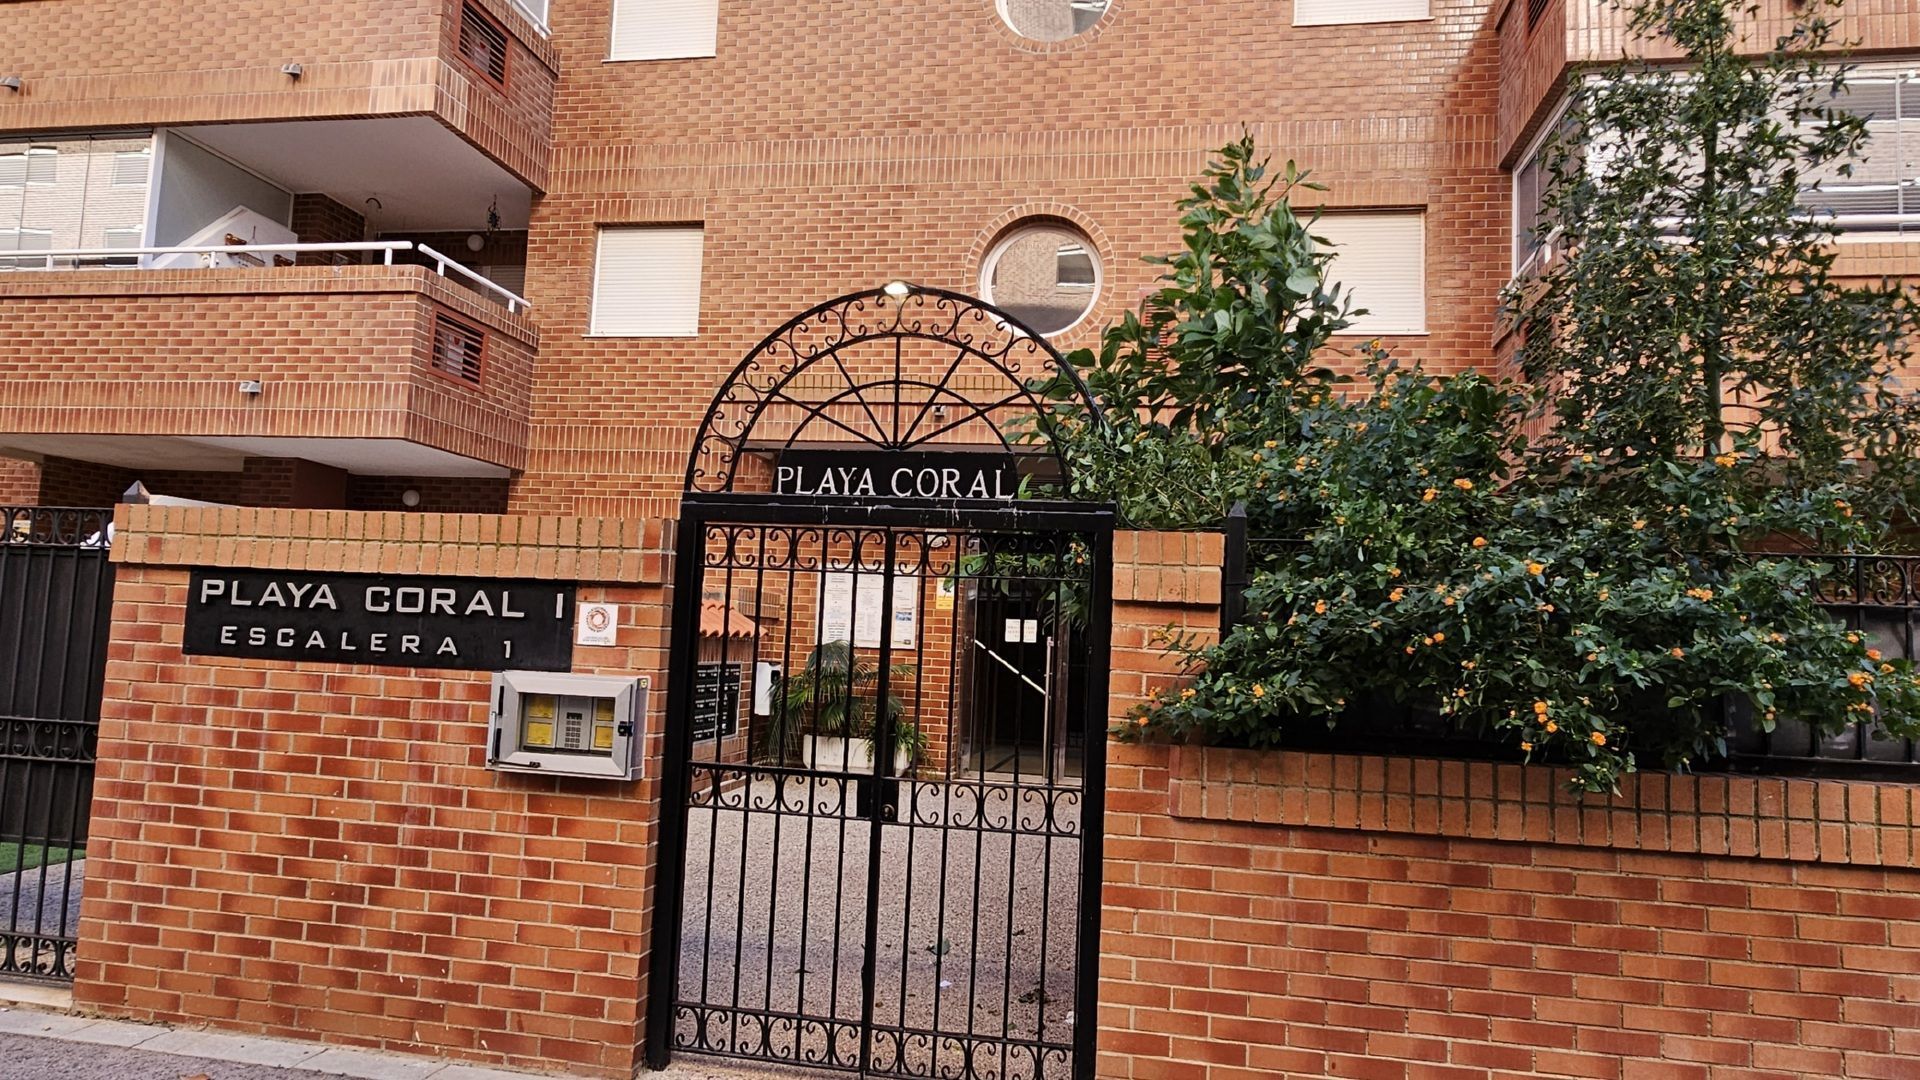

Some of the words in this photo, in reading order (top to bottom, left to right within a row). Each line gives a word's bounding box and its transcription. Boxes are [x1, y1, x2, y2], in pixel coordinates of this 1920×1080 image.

[777, 466, 876, 496] PLAYA
[891, 468, 1015, 499] CORAL
[200, 579, 338, 610] PLAYA
[365, 586, 525, 618] CORAL
[555, 593, 564, 619] I
[220, 626, 458, 656] ESCALERA
[503, 640, 511, 659] 1
